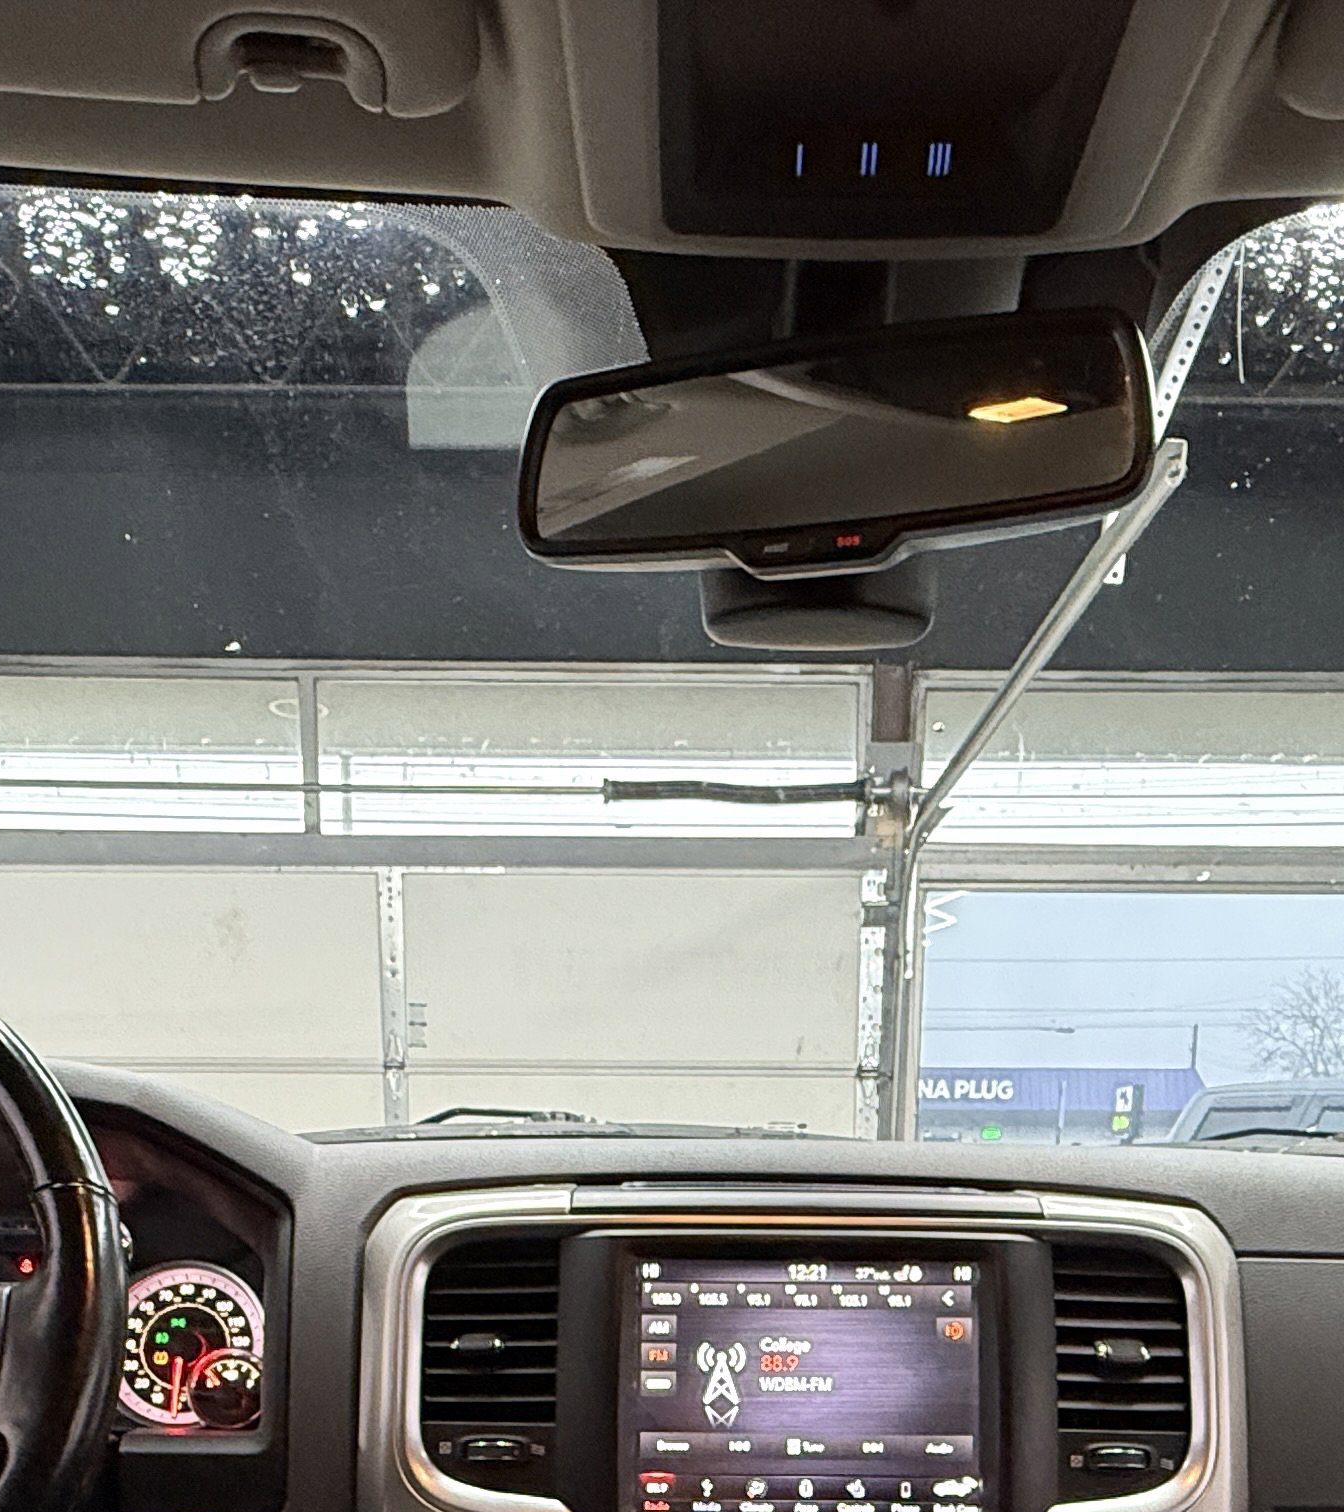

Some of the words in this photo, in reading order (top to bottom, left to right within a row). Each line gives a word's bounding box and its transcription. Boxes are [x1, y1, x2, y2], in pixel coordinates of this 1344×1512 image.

[956, 1079, 1014, 1100] PLUG
[760, 1354, 800, 1372] 88.9
[759, 1376, 833, 1393] WDBM-FM
